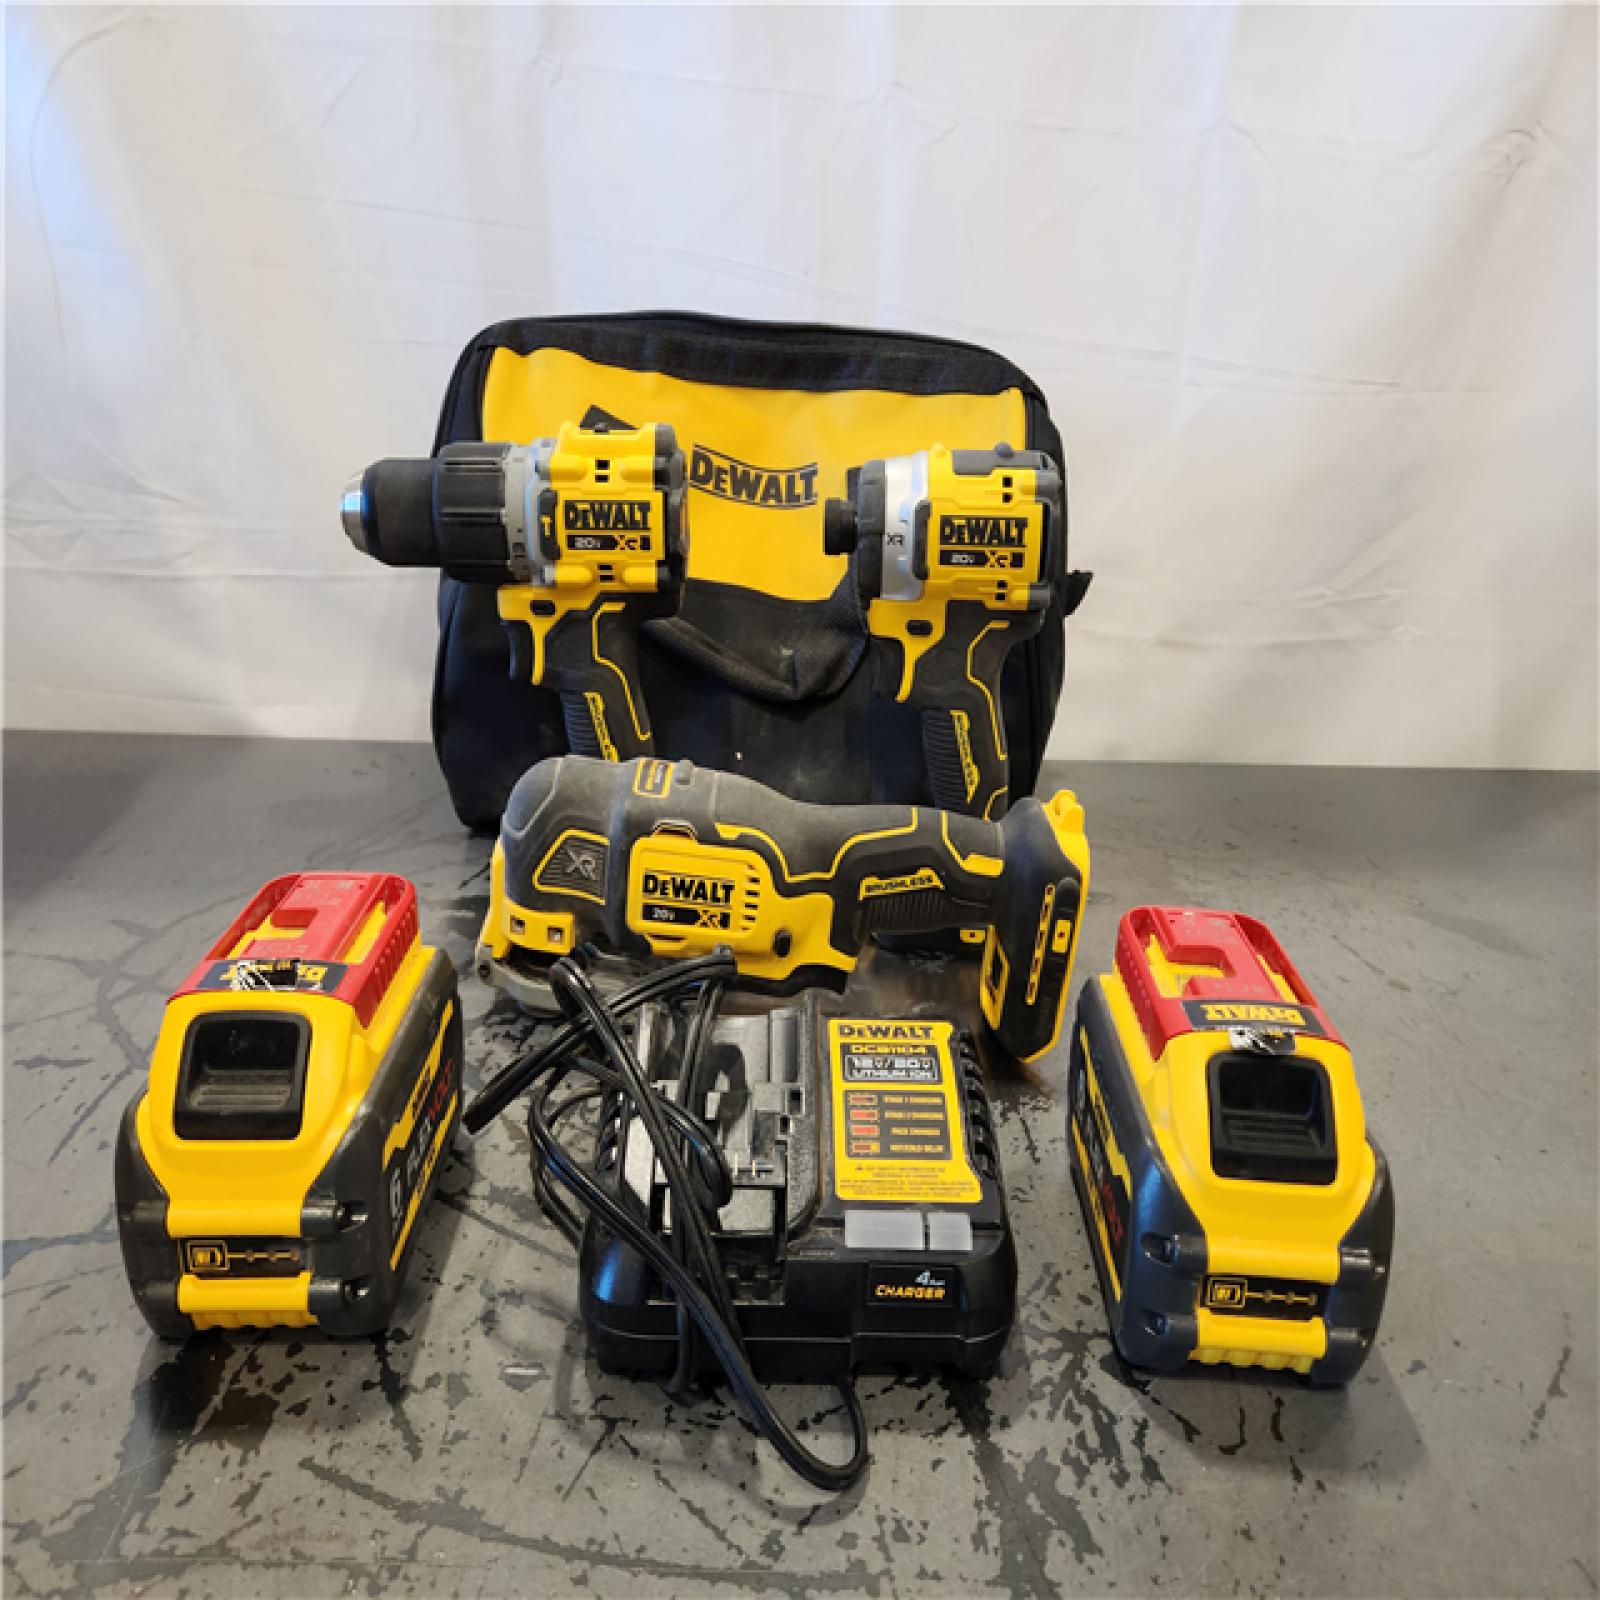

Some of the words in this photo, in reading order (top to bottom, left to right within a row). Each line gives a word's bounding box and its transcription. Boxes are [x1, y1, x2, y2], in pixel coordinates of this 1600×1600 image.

[689, 446, 818, 504] DEWALT
[564, 501, 651, 529] DEWALT
[940, 517, 1028, 547] DEWALT
[564, 848, 597, 880] XR
[642, 873, 735, 903] DEWALT
[839, 1024, 933, 1039] DEWALT
[874, 1284, 946, 1300] CHARGER
[914, 1269, 931, 1286] 4
